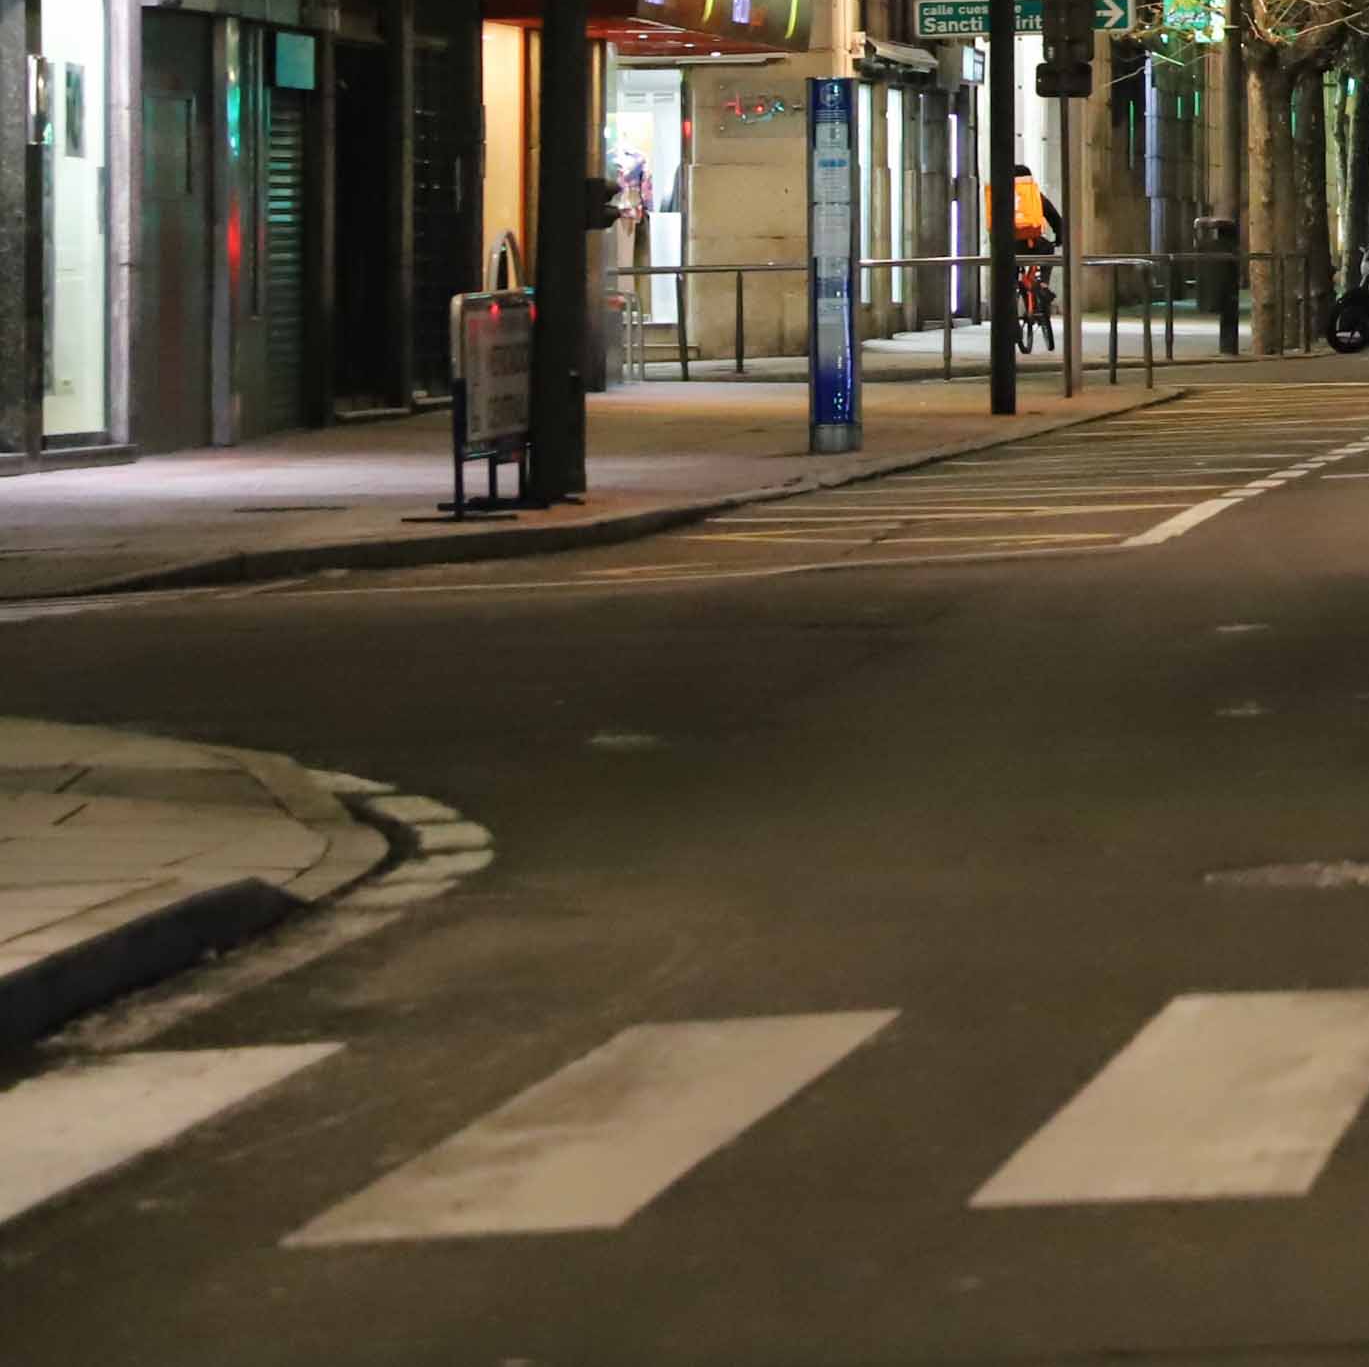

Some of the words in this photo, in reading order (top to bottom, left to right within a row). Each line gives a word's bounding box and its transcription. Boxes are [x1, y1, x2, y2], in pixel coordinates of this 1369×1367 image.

[922, 4, 954, 16] calle
[958, 4, 989, 15] cues
[923, 15, 983, 33] Sancti
